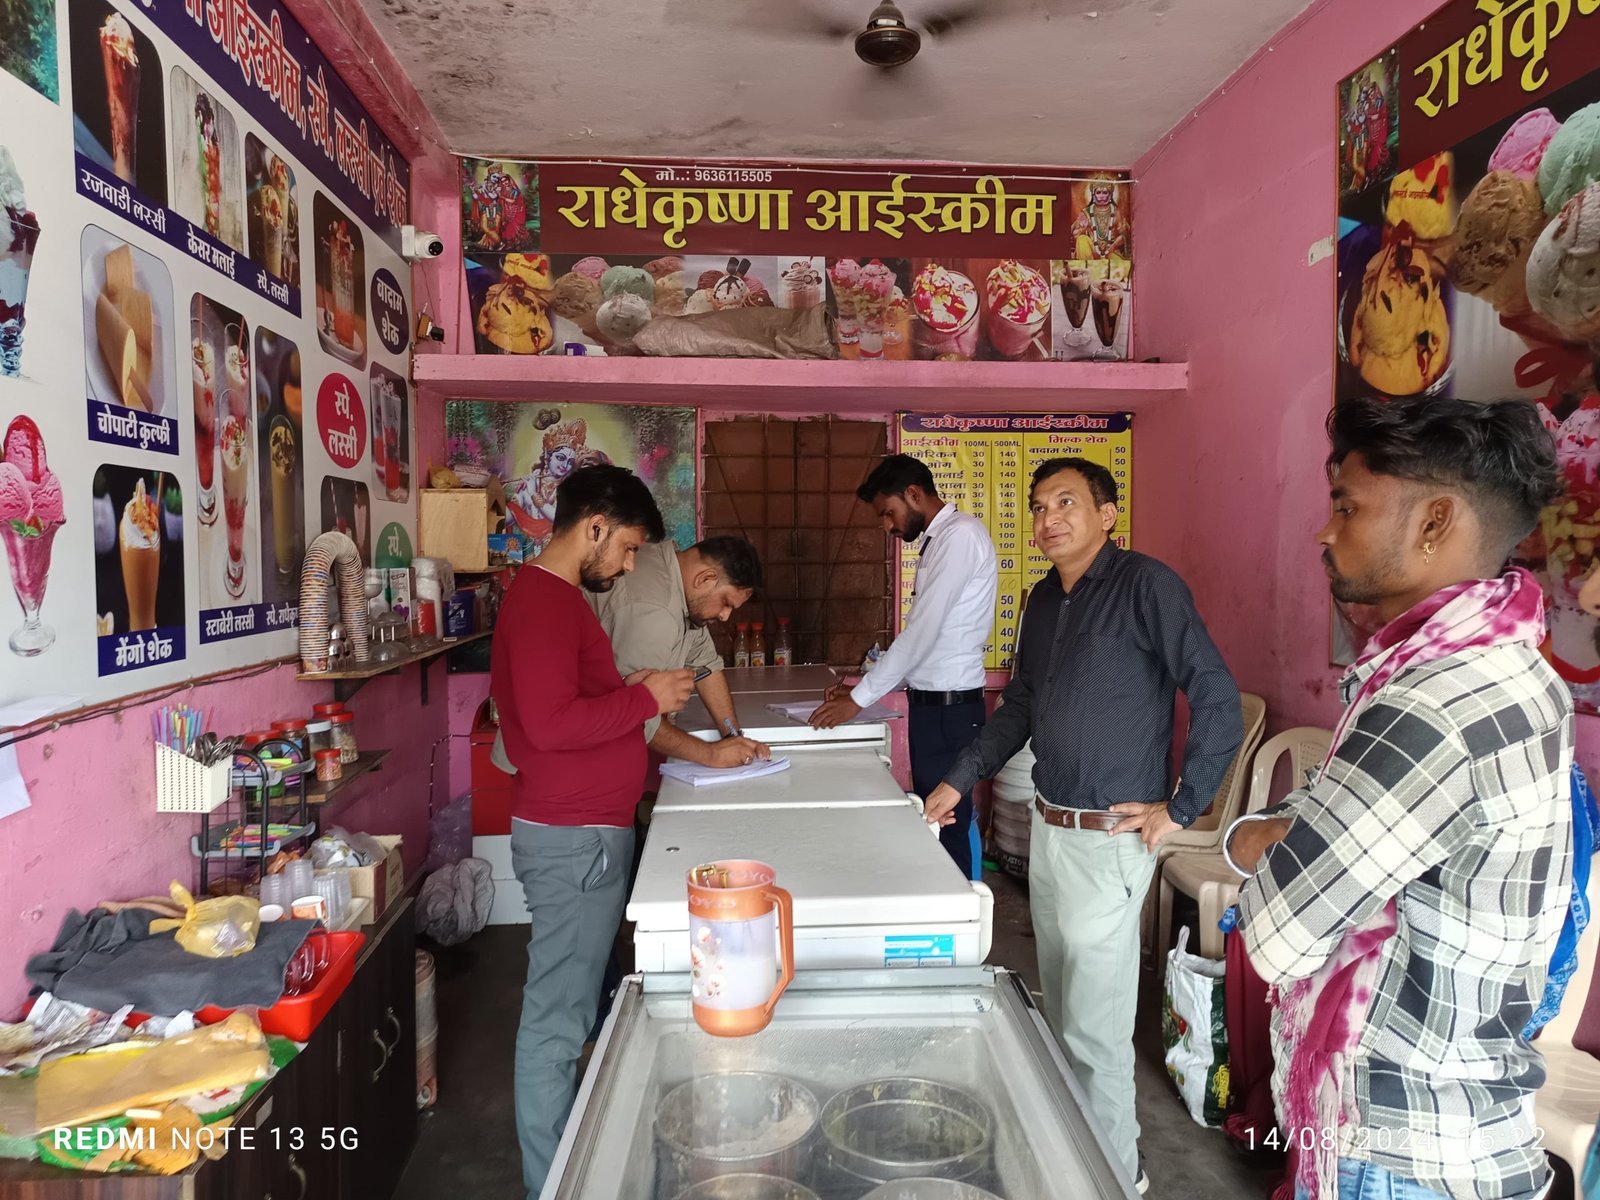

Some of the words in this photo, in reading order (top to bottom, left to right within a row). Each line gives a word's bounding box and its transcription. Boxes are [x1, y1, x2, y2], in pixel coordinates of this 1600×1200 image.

[1414, 0, 1600, 117] राधेकृ
[334, 107, 371, 200] लस्सी
[386, 153, 408, 229] शेक
[694, 170, 772, 183] 9636115505
[132, 198, 167, 235] लस्सी
[556, 168, 794, 249] राधेकृष्णा
[805, 174, 1057, 240] आईस्क्रीम
[187, 222, 211, 262] केसर
[211, 243, 236, 281] मलाई
[270, 280, 290, 306] लस्सी
[376, 276, 404, 316] बादाम
[381, 311, 400, 346] शेक
[97, 403, 138, 440] चोपाटी
[138, 417, 171, 450] कुल्फी
[920, 414, 1010, 432] राधेकृष्णा
[1011, 414, 1109, 430] आईस्क्रीम
[327, 425, 358, 461] लस्सी
[1048, 434, 1082, 444] मिल्क
[1084, 434, 1108, 443] शेक
[1062, 445, 1083, 454] शेक
[1114, 446, 1126, 454] 50
[1114, 458, 1126, 466] 50
[1114, 470, 1126, 478] 50
[1115, 482, 1126, 490] 50
[1000, 559, 1014, 569] 60
[1000, 595, 1014, 605] 50
[234, 607, 255, 632] लस्सी
[1000, 610, 1014, 619] 40
[1000, 627, 1014, 637] 40
[115, 634, 146, 668] मेंगो
[147, 631, 173, 662] शेक
[1000, 643, 1014, 653] 40
[1000, 658, 1013, 669] 40
